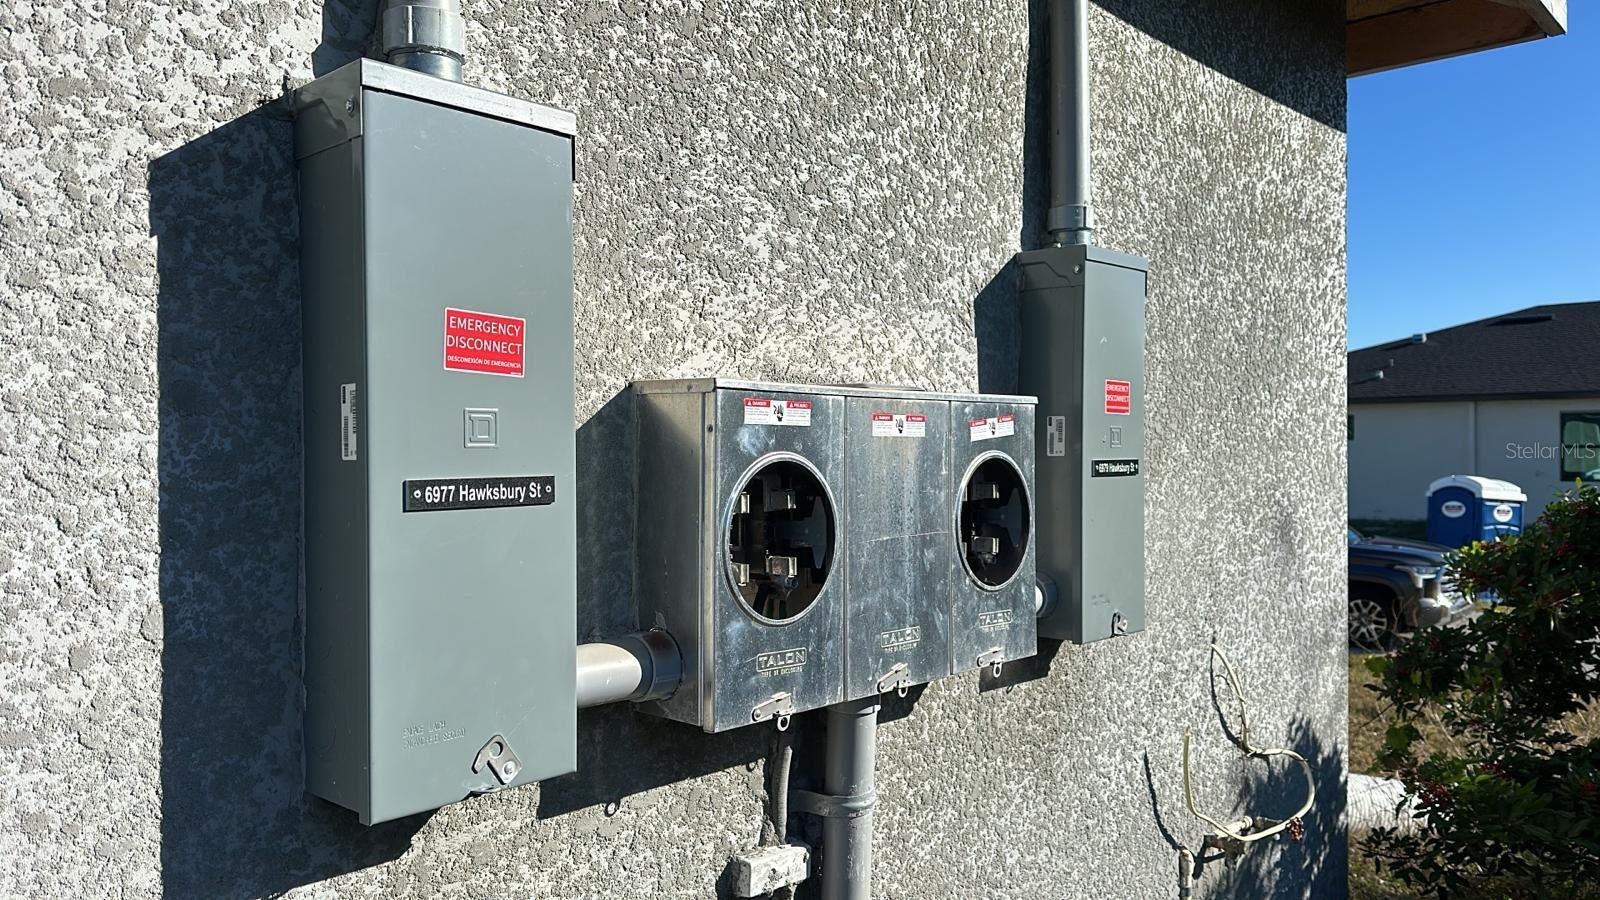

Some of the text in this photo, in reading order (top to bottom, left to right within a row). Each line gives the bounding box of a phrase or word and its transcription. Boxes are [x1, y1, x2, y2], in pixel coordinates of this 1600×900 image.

[449, 316, 521, 337] EMERGENCY
[446, 335, 522, 355] DISCONNECT
[491, 361, 522, 369] EMERGENCIA
[425, 482, 541, 503] 6977 Hawksbury St
[980, 611, 1011, 626] TALON
[882, 628, 919, 645] TALON
[758, 650, 805, 668] TALON
